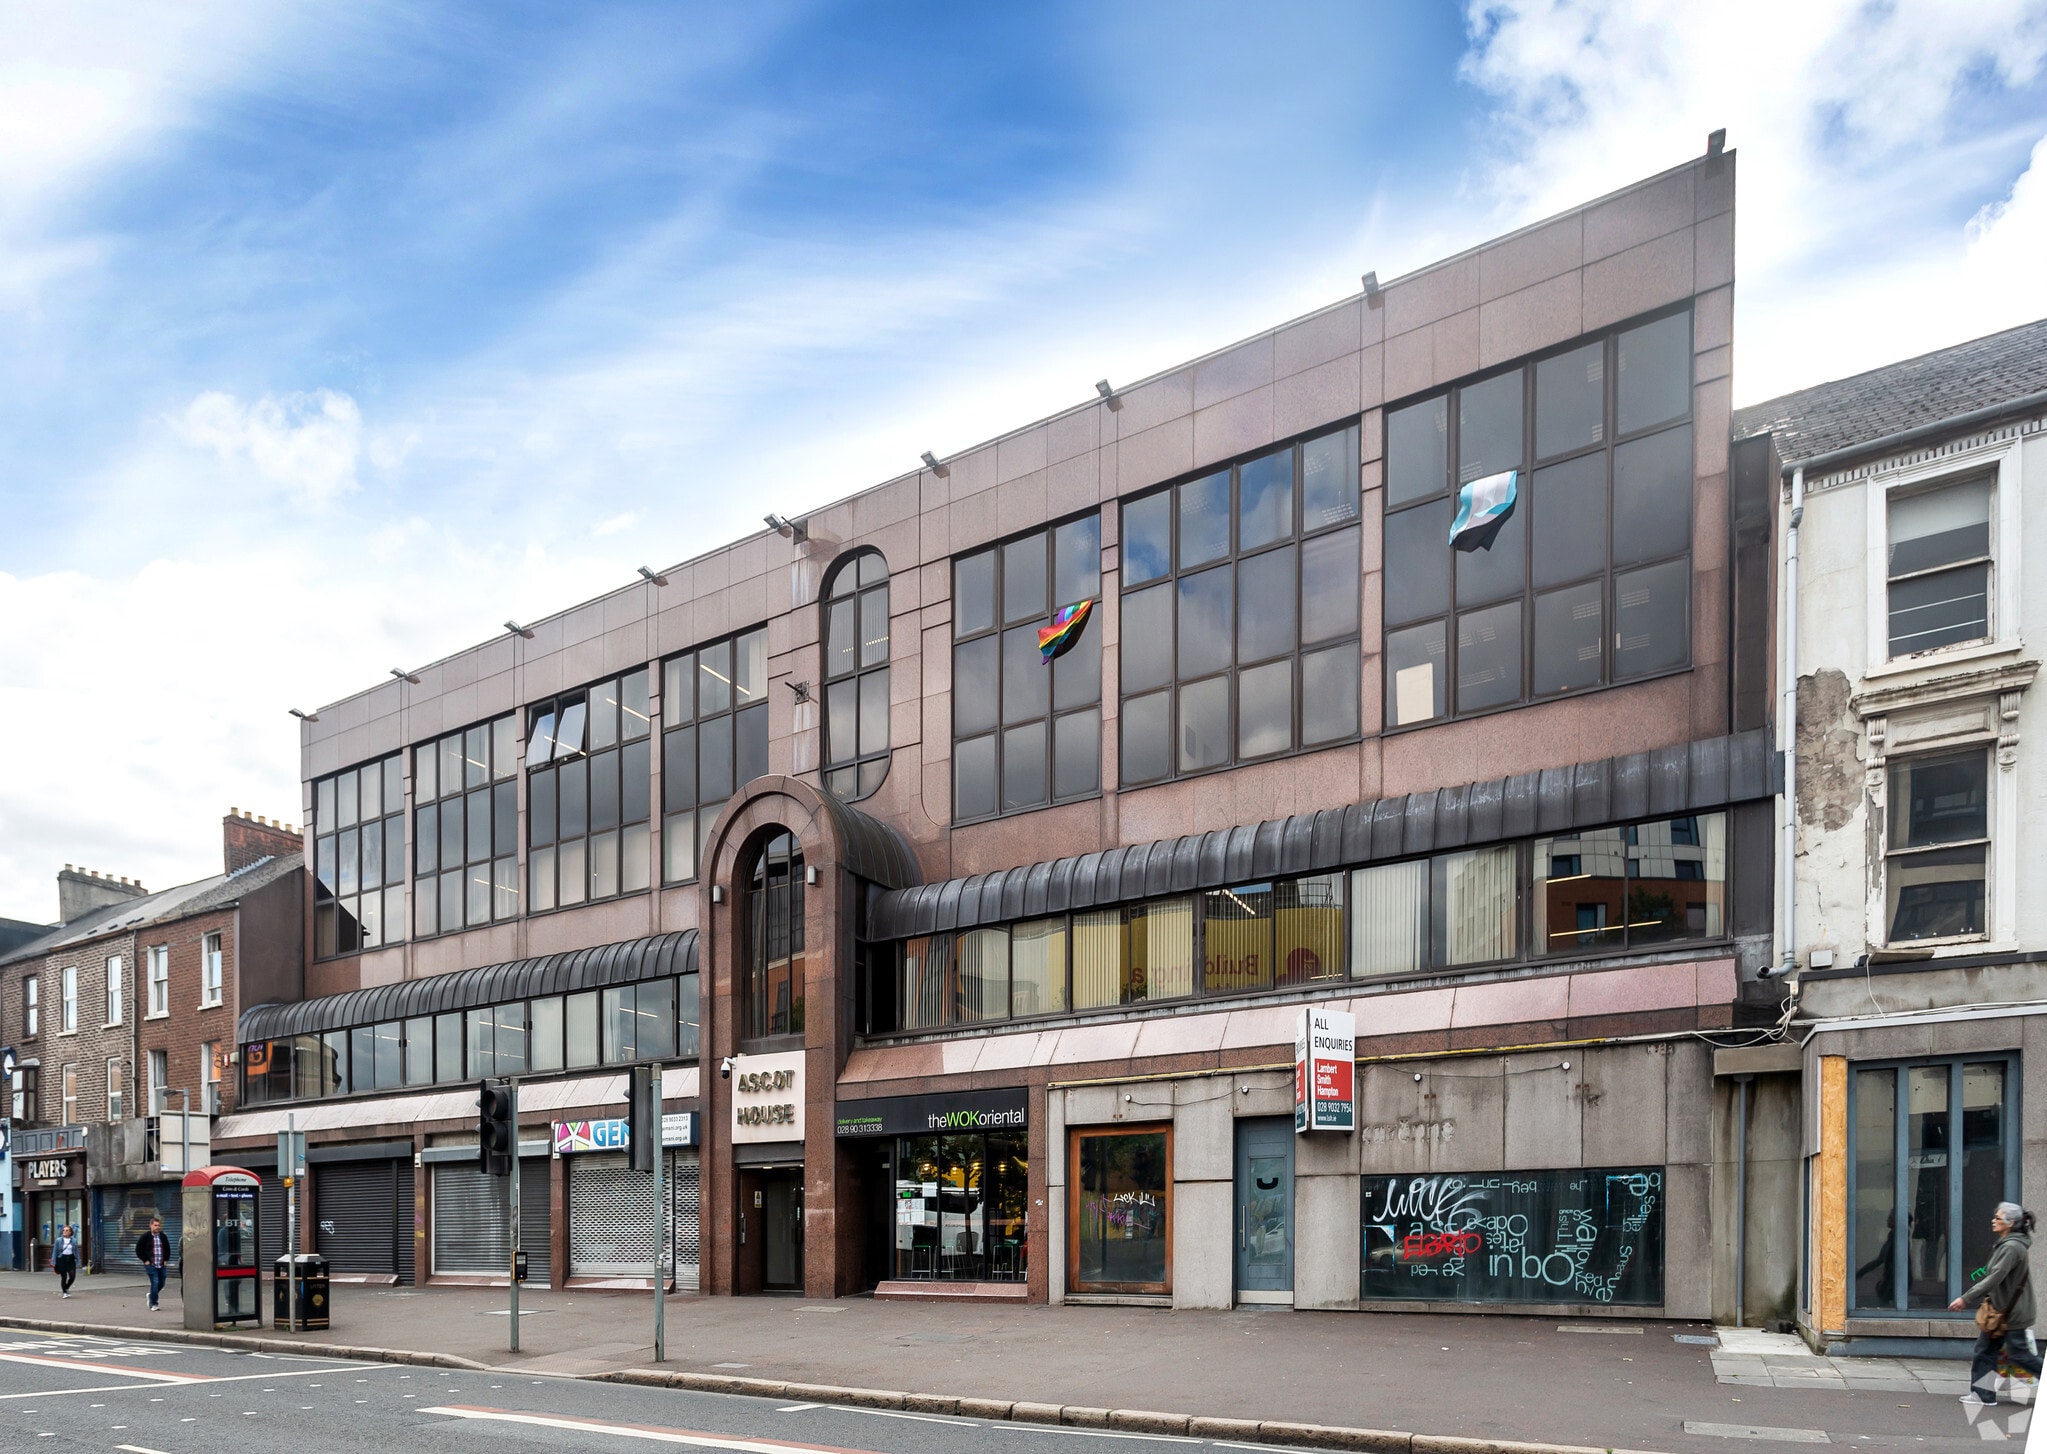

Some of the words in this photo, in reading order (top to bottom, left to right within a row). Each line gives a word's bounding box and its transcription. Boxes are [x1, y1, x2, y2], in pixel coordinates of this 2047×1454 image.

[1314, 1018, 1328, 1030] ALL
[1314, 1036, 1353, 1052] ENQUIRIES
[1317, 1062, 1338, 1074] Lambert
[737, 1070, 796, 1092] ASCOT
[1317, 1074, 1332, 1085] Smith
[1317, 1085, 1338, 1098] Hampton
[1317, 1102, 1328, 1112] 028
[736, 1104, 794, 1124] HOUSE
[837, 1126, 850, 1134] 028
[850, 1125, 858, 1133] 90
[28, 1159, 67, 1178] PLAYERS
